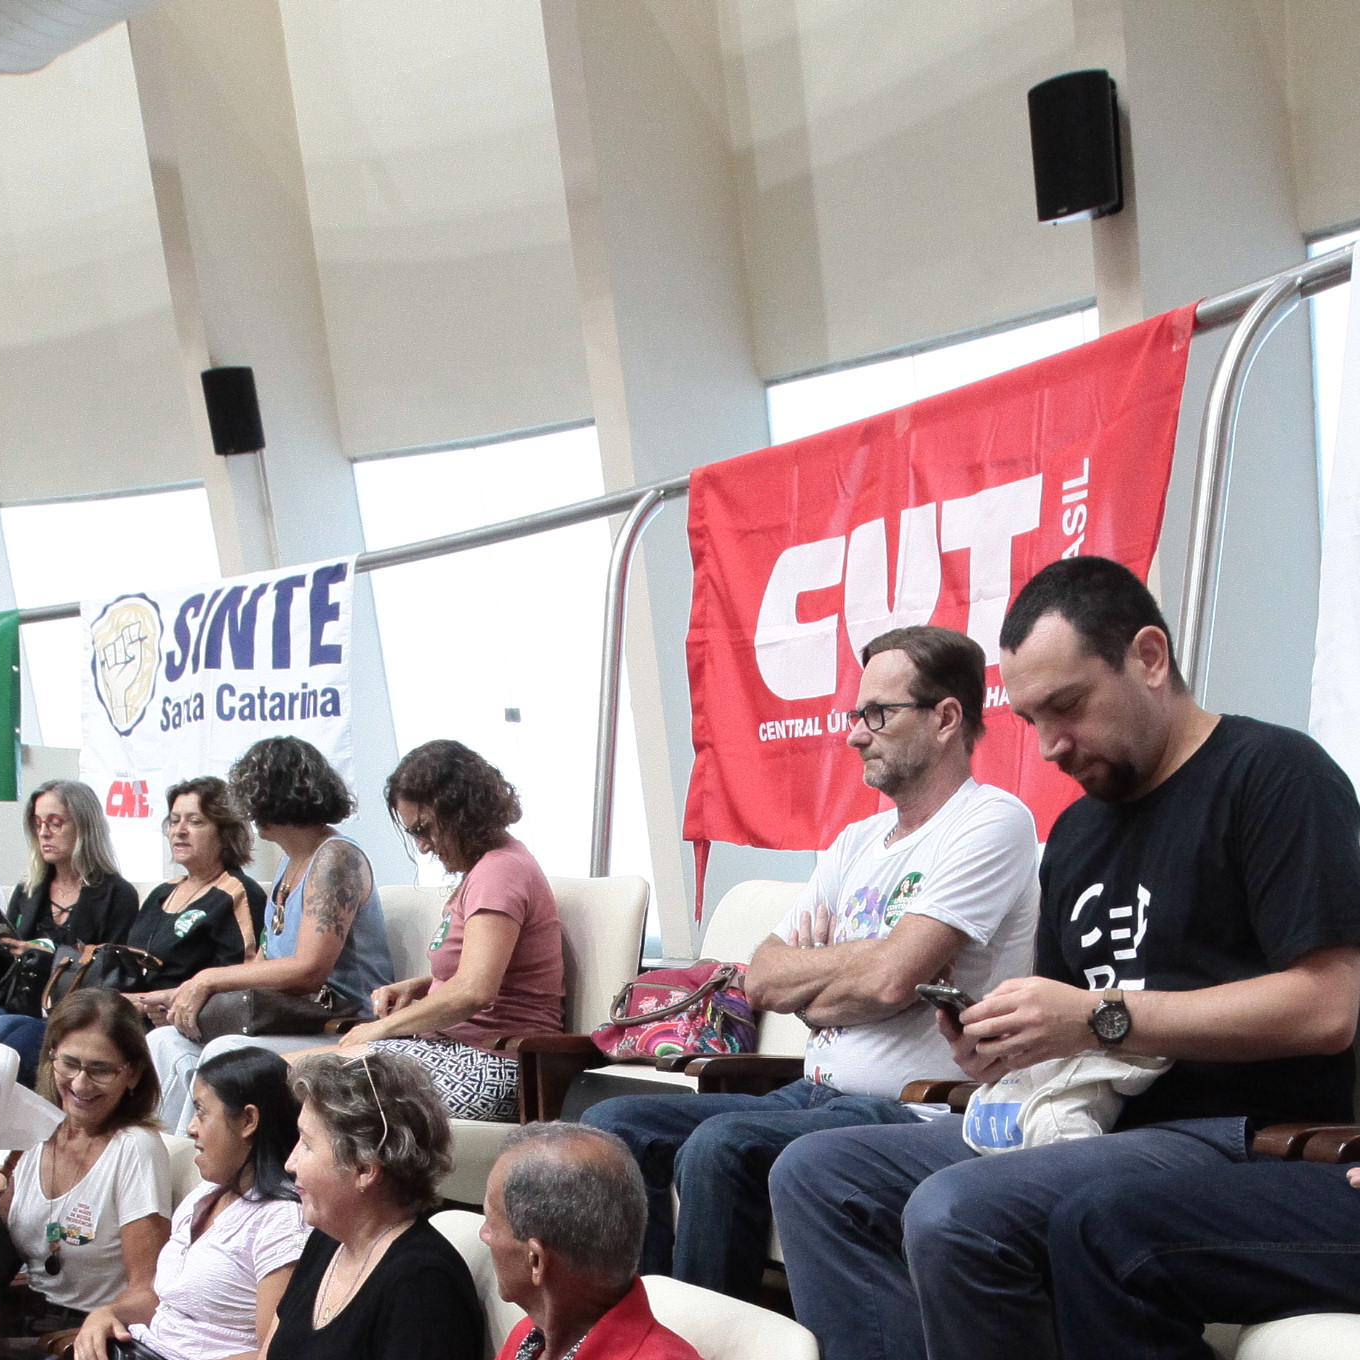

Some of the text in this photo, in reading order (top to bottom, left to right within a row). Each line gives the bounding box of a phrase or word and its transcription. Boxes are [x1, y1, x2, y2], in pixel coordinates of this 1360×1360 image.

[163, 562, 349, 682] SINTE
[754, 472, 1043, 701] CUT
[215, 682, 342, 722] Catarina
[759, 717, 823, 743] CENTRAL
